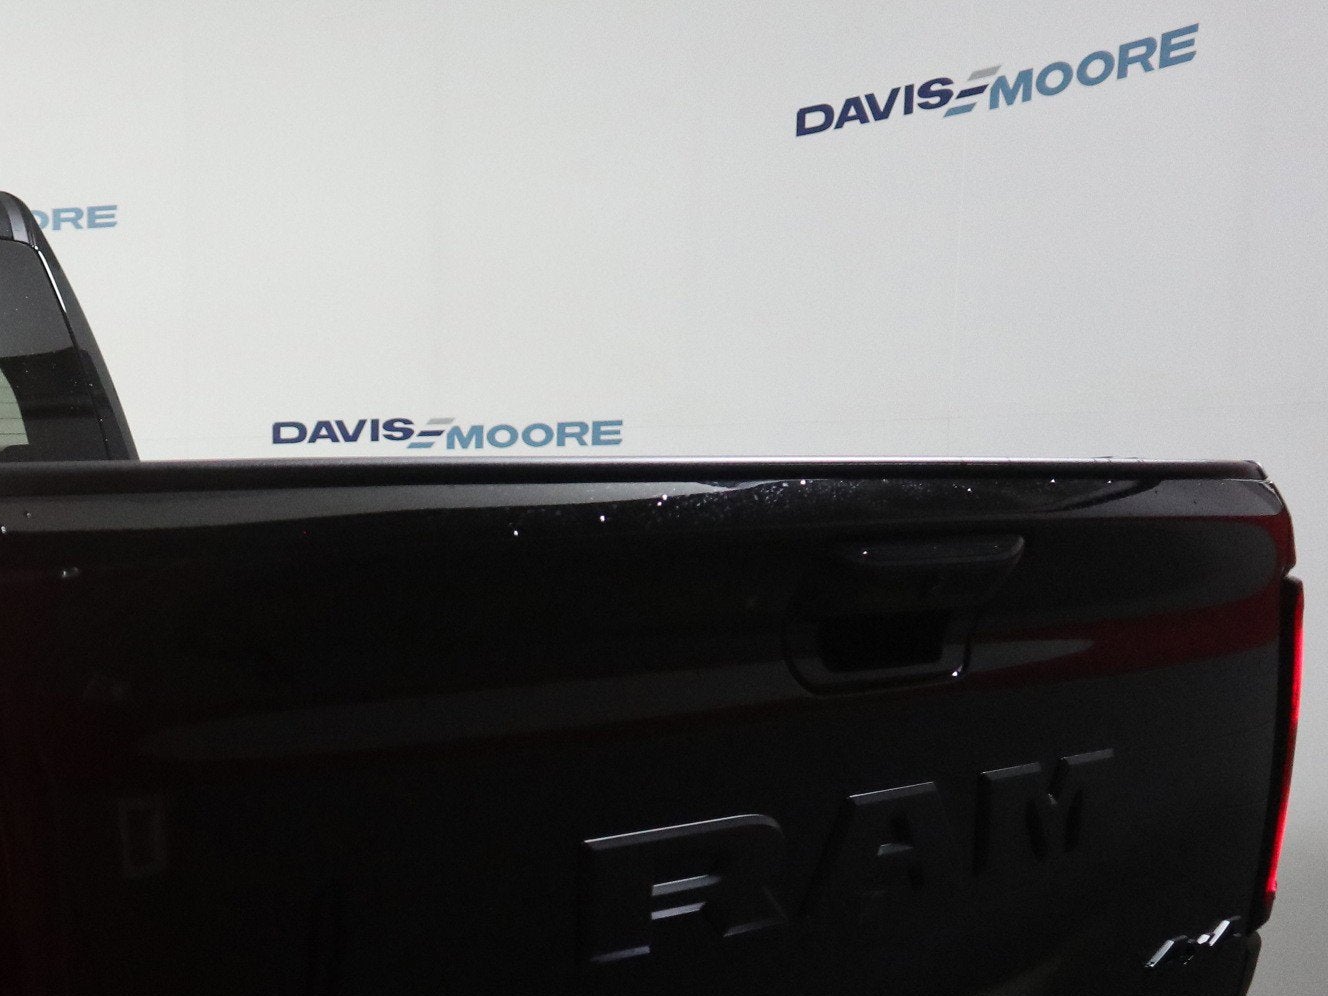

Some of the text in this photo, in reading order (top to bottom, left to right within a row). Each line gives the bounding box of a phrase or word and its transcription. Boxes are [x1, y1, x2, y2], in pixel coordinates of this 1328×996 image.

[795, 23, 1199, 137] DAVIS MOORE
[272, 417, 623, 450] DAVIS MOORE
[576, 748, 1114, 967] RAM
